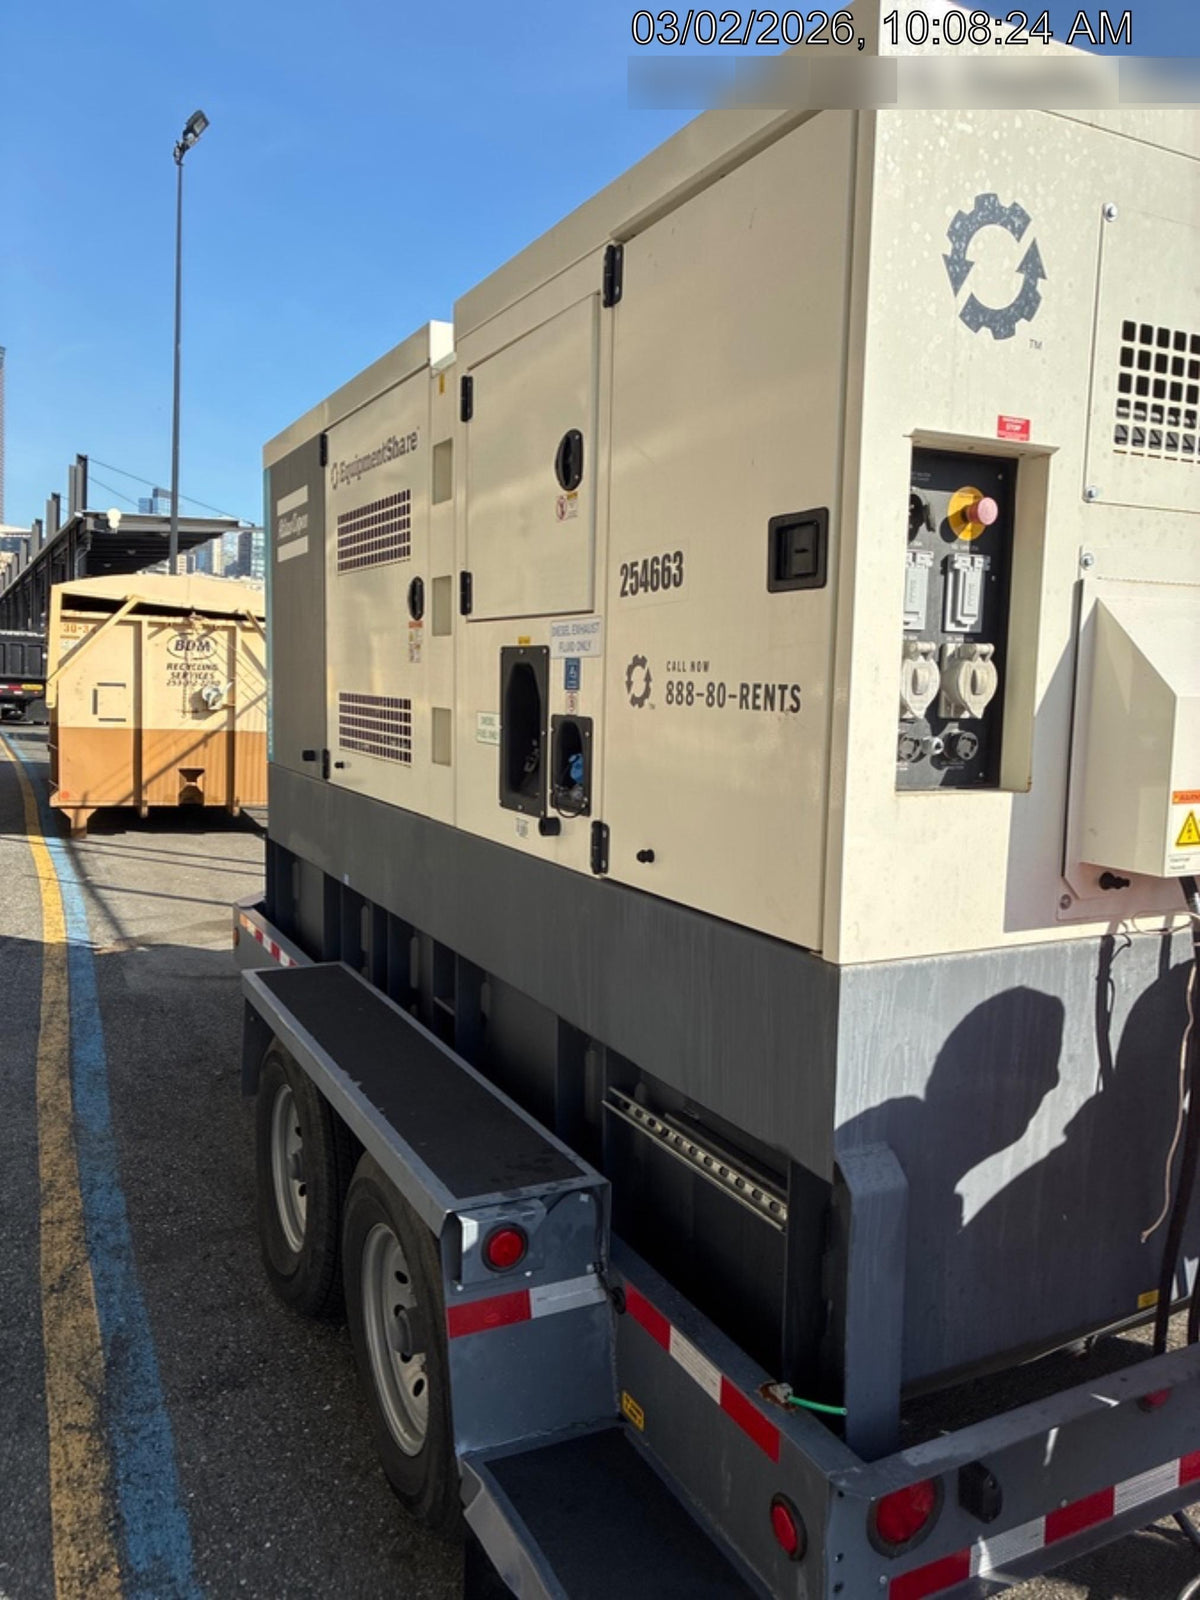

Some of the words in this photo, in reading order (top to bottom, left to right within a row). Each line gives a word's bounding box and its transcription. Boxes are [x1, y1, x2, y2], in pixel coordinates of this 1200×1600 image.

[340, 431, 418, 485] EquipmentShare
[619, 550, 684, 598] 254663
[174, 639, 211, 652] BDM
[666, 660, 687, 673] CALL
[690, 660, 710, 673] NOW
[666, 680, 802, 713] 888-80-RENTS
